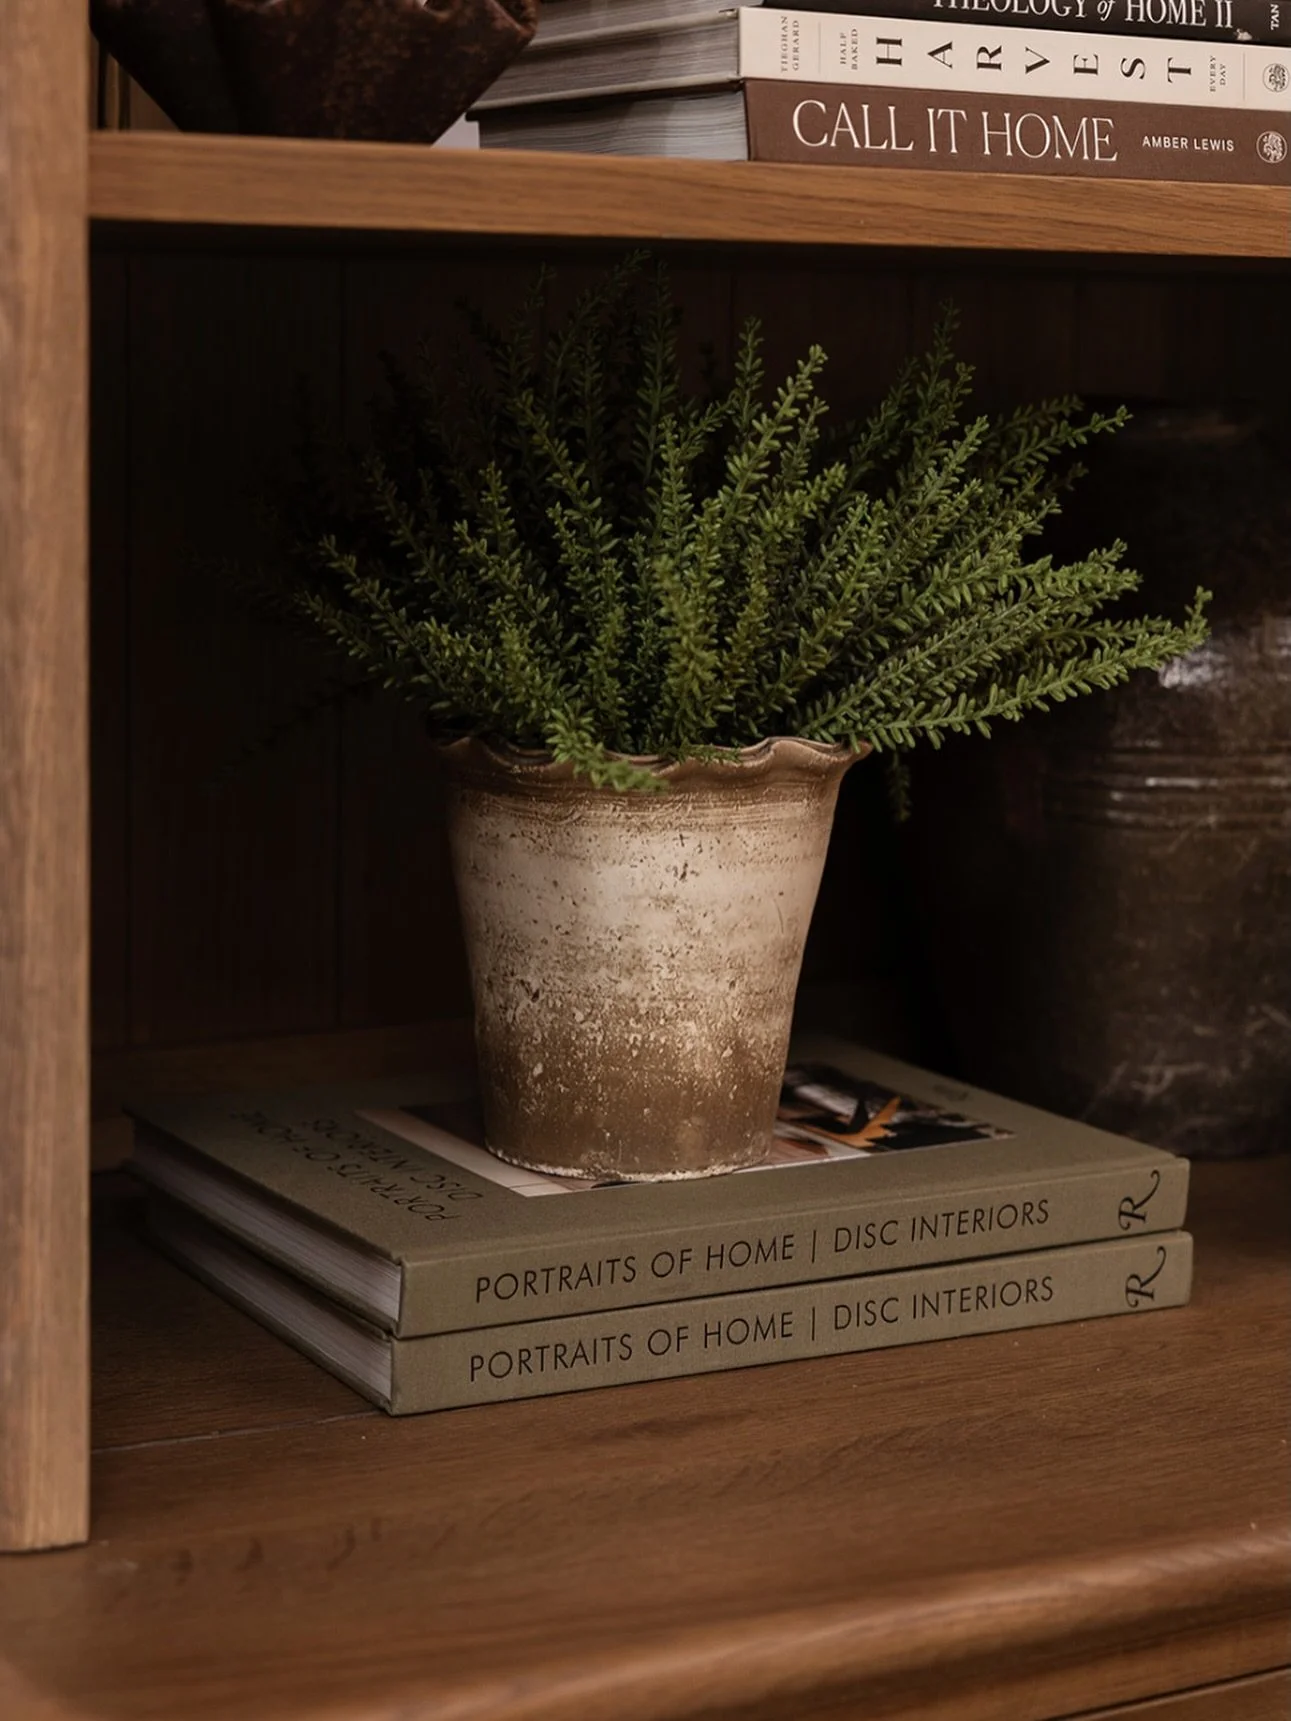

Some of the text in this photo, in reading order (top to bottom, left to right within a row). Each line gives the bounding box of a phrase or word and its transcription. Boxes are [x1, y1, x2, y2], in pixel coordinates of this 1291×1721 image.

[1097, 0, 1116, 21] of
[1125, 0, 1207, 26] HOME
[1215, 0, 1233, 28] II
[1270, 4, 1280, 31] TAN
[780, 15, 788, 72] TIEGHAN
[792, 20, 800, 71] GERARD
[839, 32, 847, 64] HALF
[876, 37, 1192, 83] HARVEST
[793, 99, 1118, 162] CALL IT HOME
[1142, 135, 1235, 152] AMBER LEWIS
[475, 1199, 1050, 1304] PORTRAITS OF HOME DISC INTERIORS
[470, 1276, 1054, 1383] PORTRAITS OF HOME DISC INTERIORS
